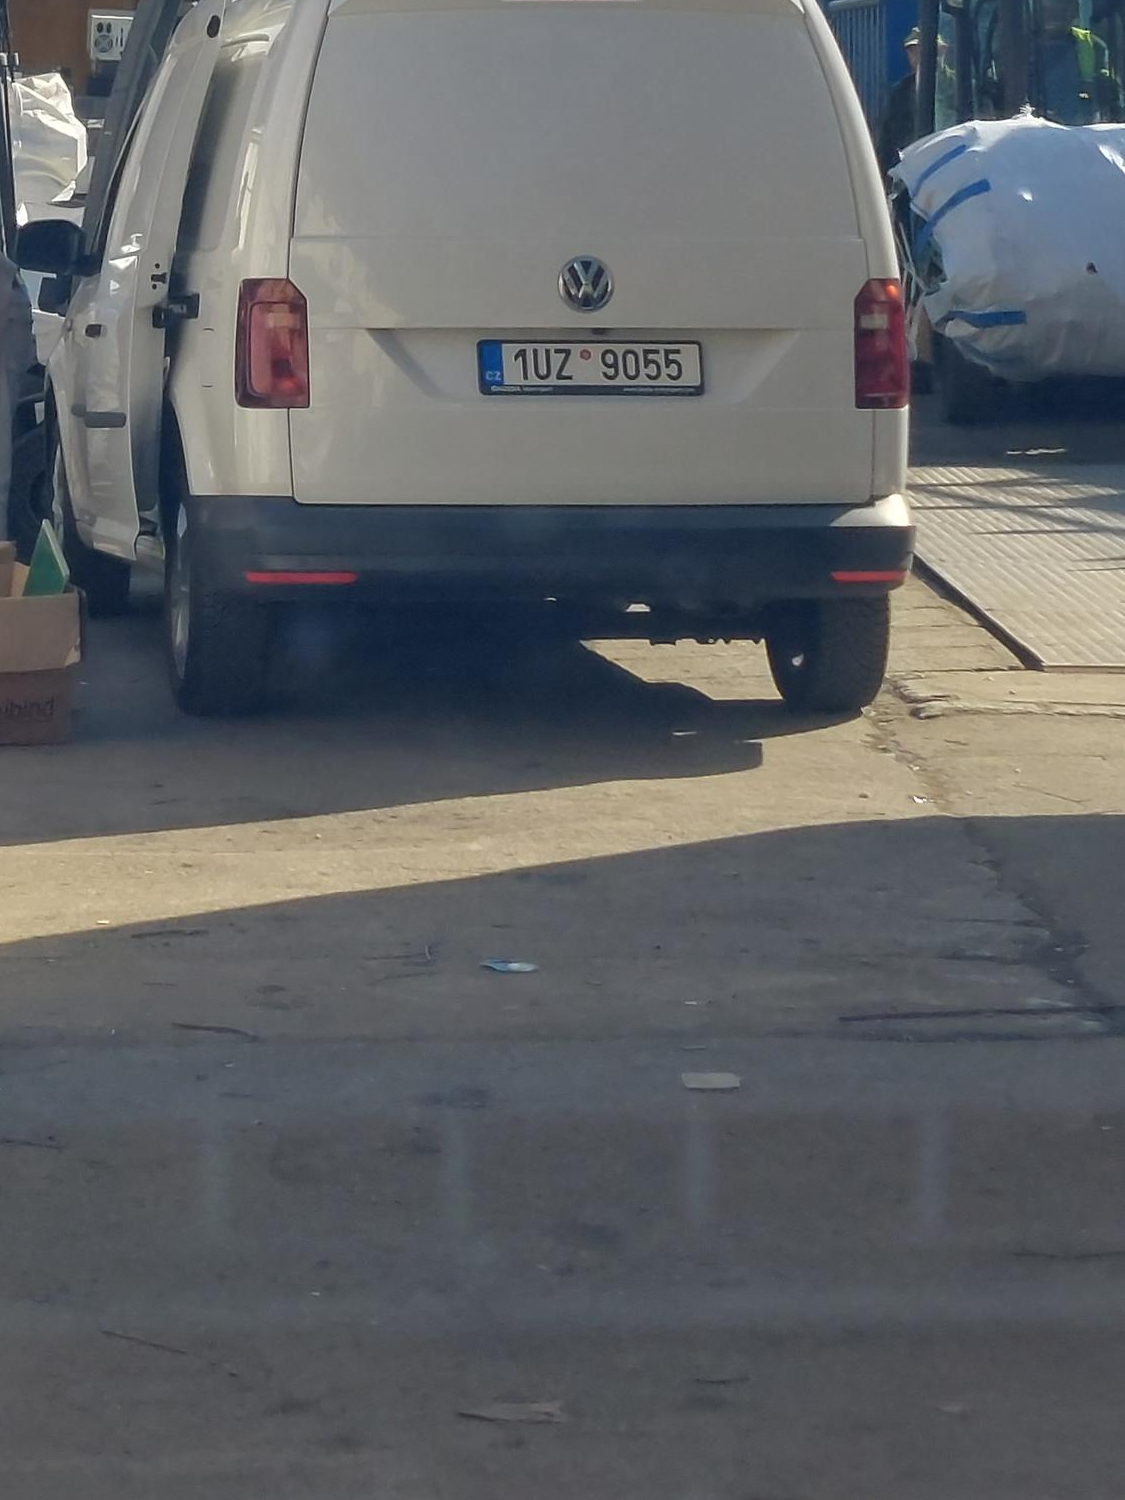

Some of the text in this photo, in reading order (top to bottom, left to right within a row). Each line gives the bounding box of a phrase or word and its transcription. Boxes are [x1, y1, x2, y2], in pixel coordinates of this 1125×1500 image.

[513, 347, 684, 382] 1UZ 9055
[485, 371, 502, 381] CZ
